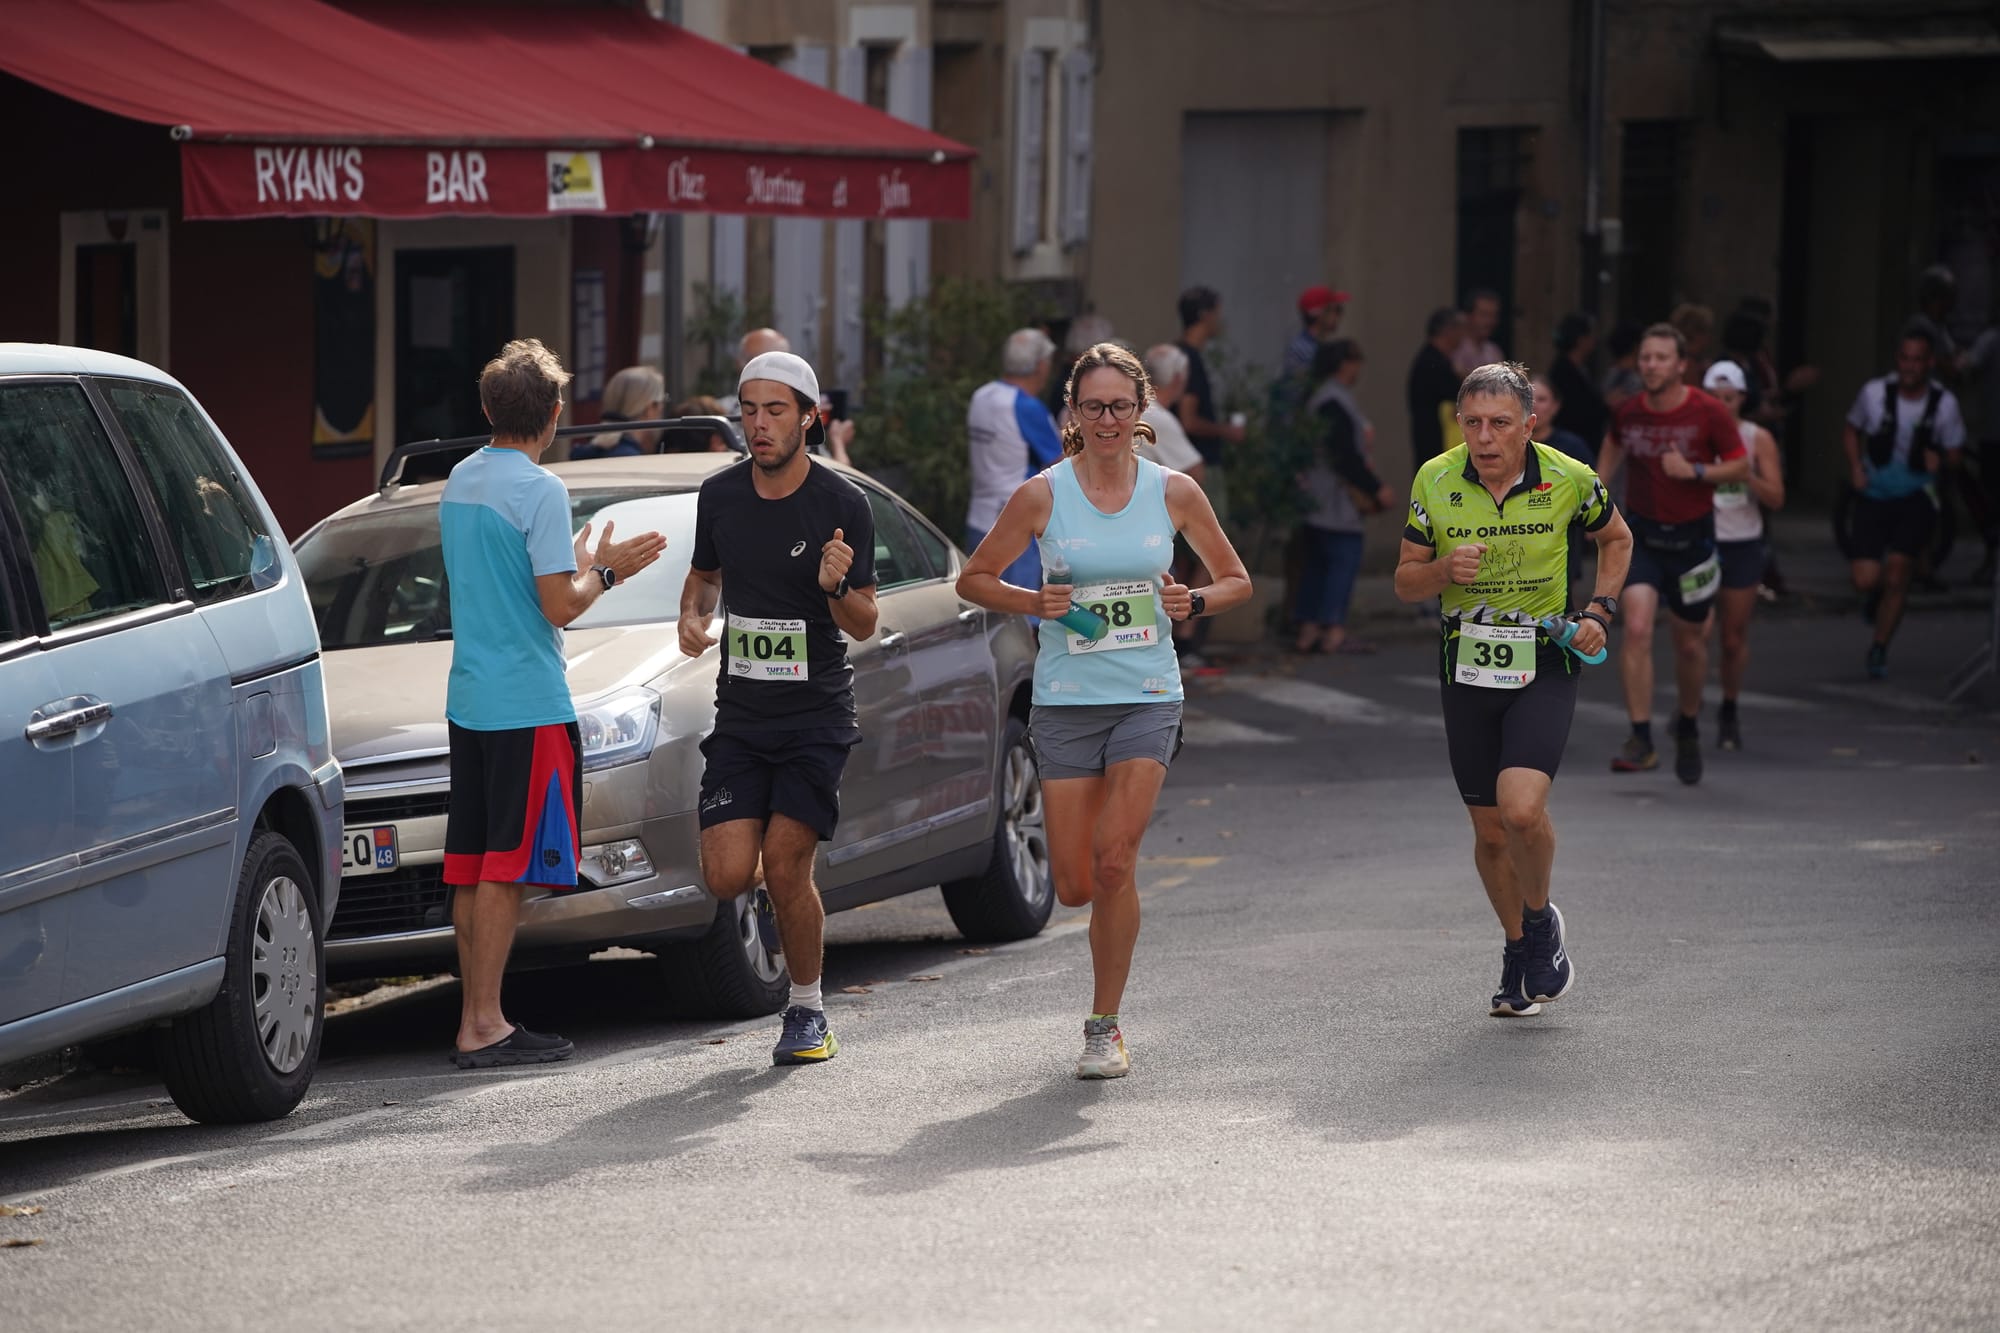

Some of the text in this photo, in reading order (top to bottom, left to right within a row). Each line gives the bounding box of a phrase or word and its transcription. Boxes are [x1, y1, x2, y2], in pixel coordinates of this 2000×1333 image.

[254, 147, 488, 203] RYAN'S BAR
[667, 157, 706, 202] Chez
[1528, 496, 1552, 504] PLAZA
[1446, 523, 1554, 539] CAP ORMESSON
[1516, 576, 1553, 585] ORMESSON
[1518, 585, 1538, 593] PIED
[1115, 632, 1142, 640] TUFF'S
[737, 633, 795, 660] 104
[1473, 642, 1514, 668] 39
[1142, 678, 1158, 689] 42
[377, 849, 393, 865] 48
